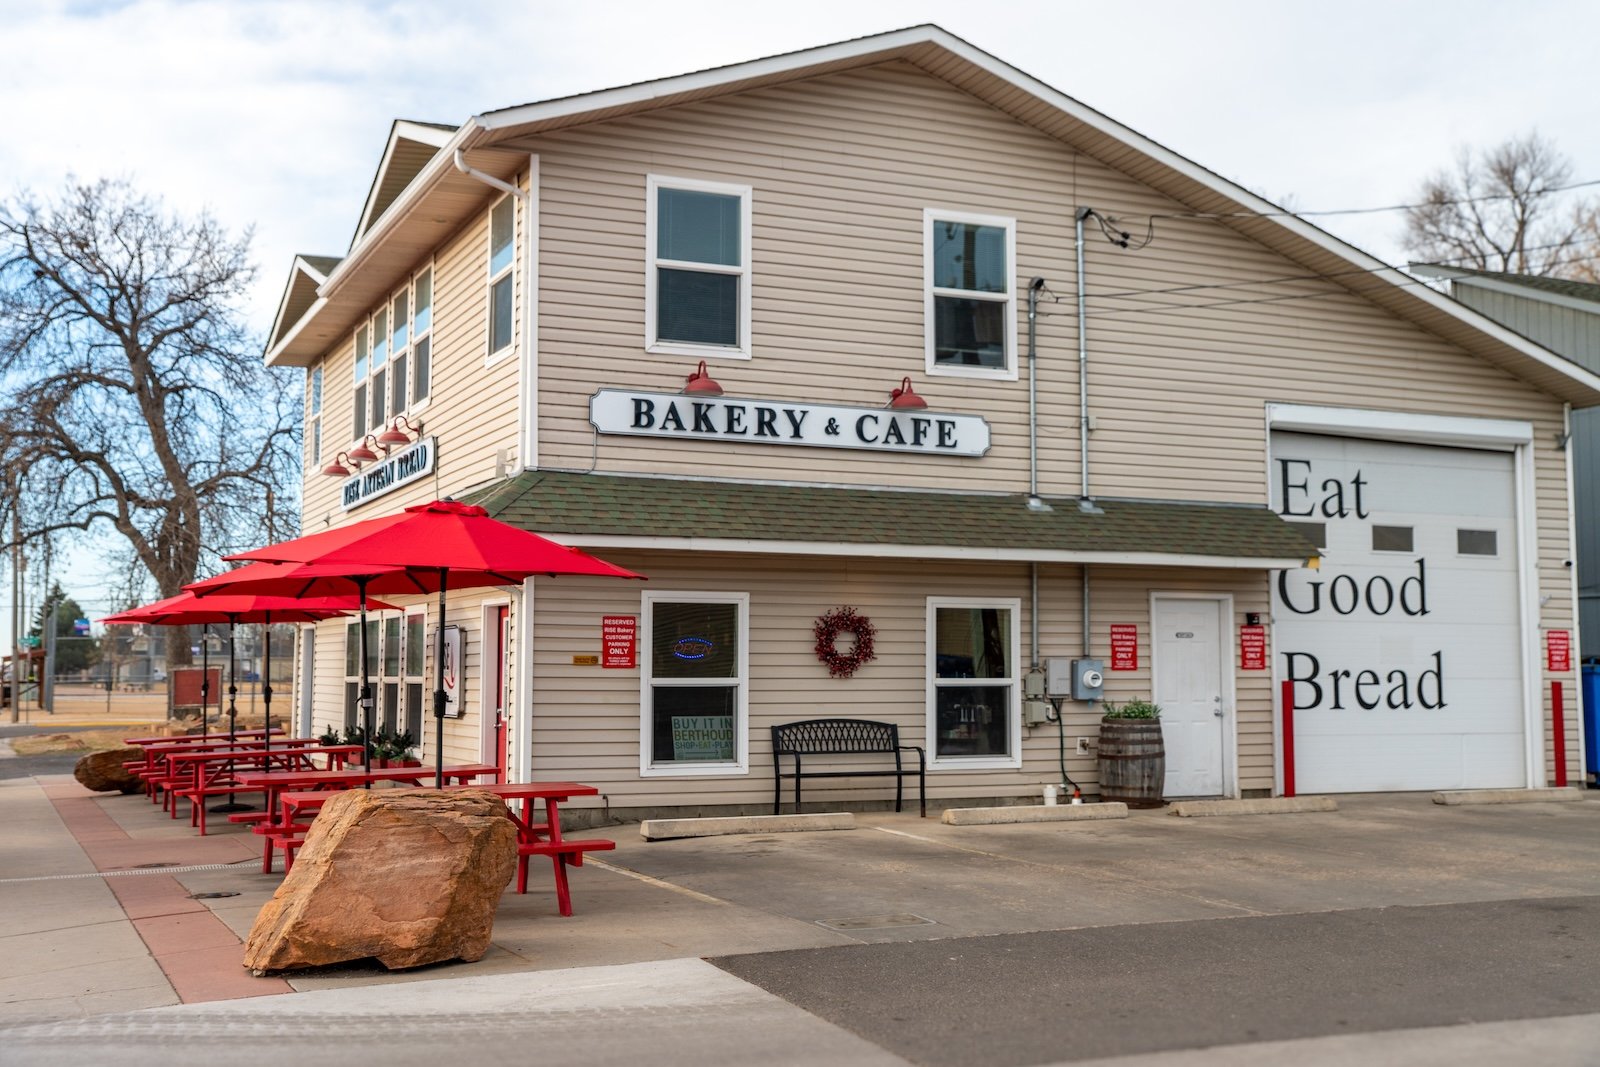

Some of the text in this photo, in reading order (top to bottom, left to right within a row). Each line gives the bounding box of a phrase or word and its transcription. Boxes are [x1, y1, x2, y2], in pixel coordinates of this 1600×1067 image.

[630, 398, 958, 448] BAKERY & CAFE
[362, 460, 395, 497] ARTISAN
[397, 444, 427, 481] BREAD
[1275, 458, 1369, 519] Eat
[1278, 558, 1431, 616] Good
[1280, 650, 1448, 710] Bread
[673, 718, 732, 729] BUY IT IN
[674, 730, 733, 740] BERTHOUD
